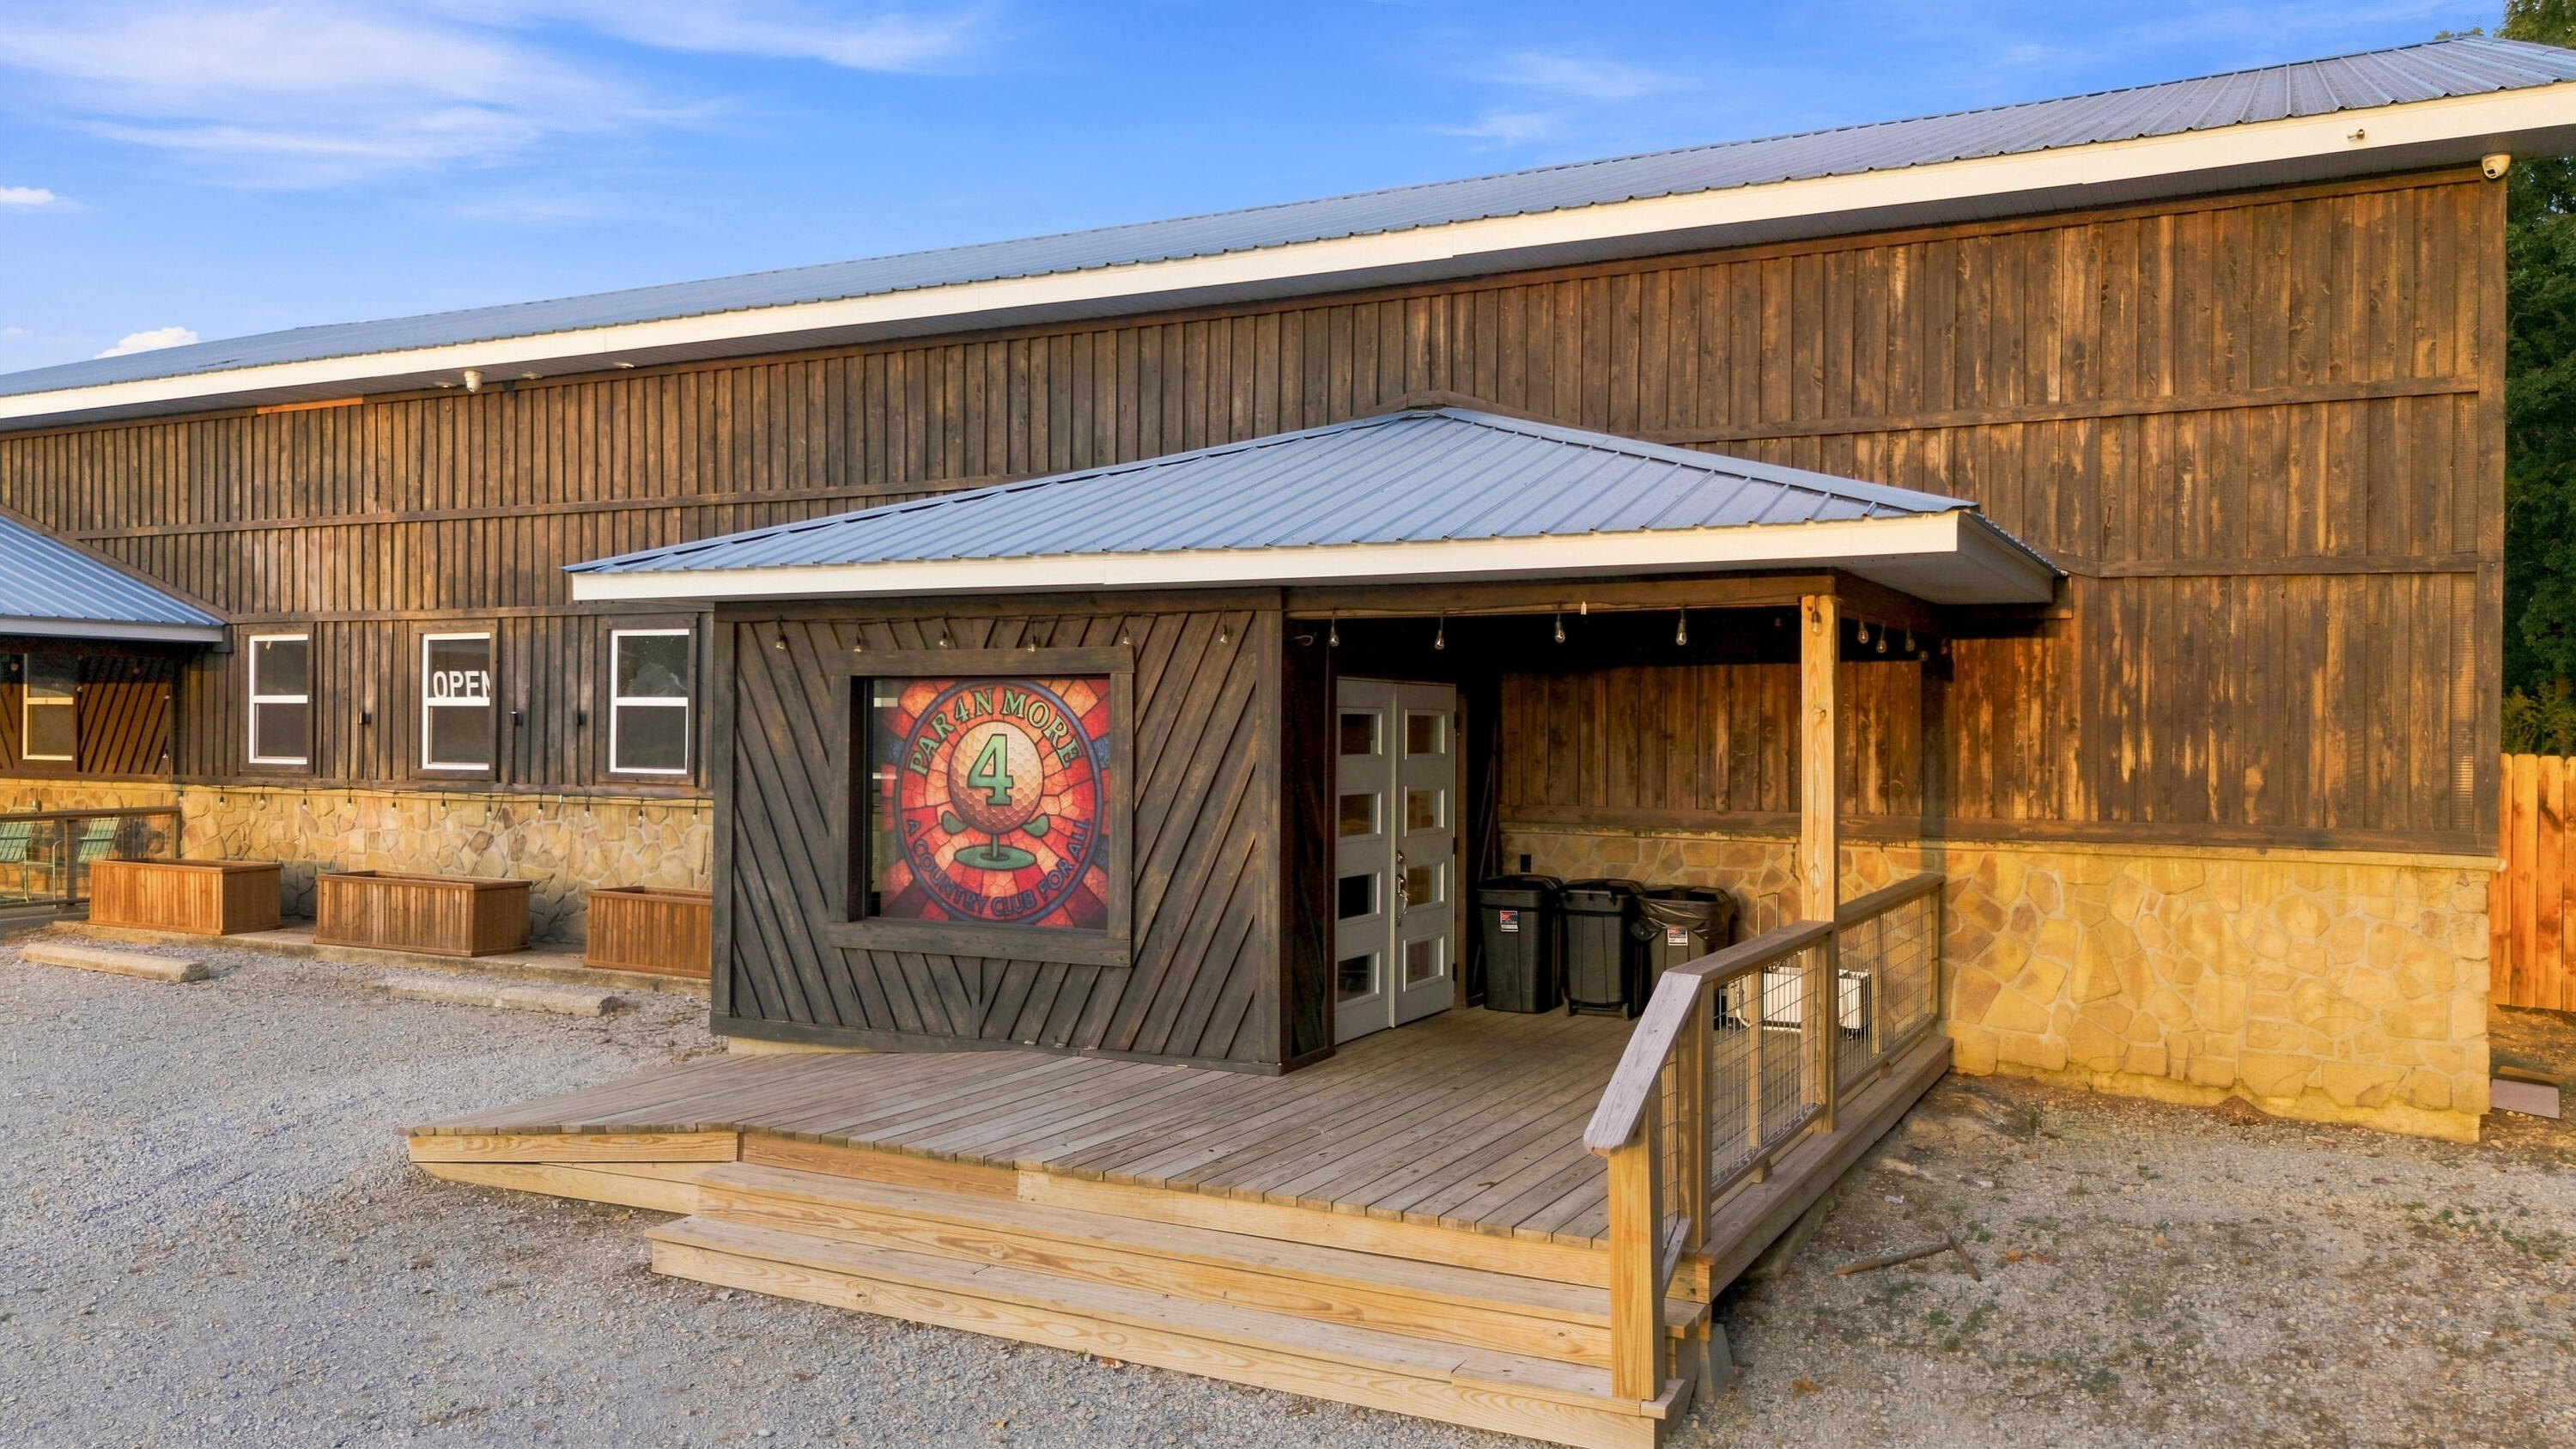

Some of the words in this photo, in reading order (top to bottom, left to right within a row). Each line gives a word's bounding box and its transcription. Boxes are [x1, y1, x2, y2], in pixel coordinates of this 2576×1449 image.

[908, 712, 956, 776] PAR
[1002, 689, 1084, 768] MORE
[967, 733, 1014, 806] 4
[907, 818, 921, 837] A
[1066, 817, 1091, 860] ALL
[913, 838, 990, 915] COUNTRY
[1036, 857, 1074, 900] FOR
[990, 889, 1036, 916] CLUB
